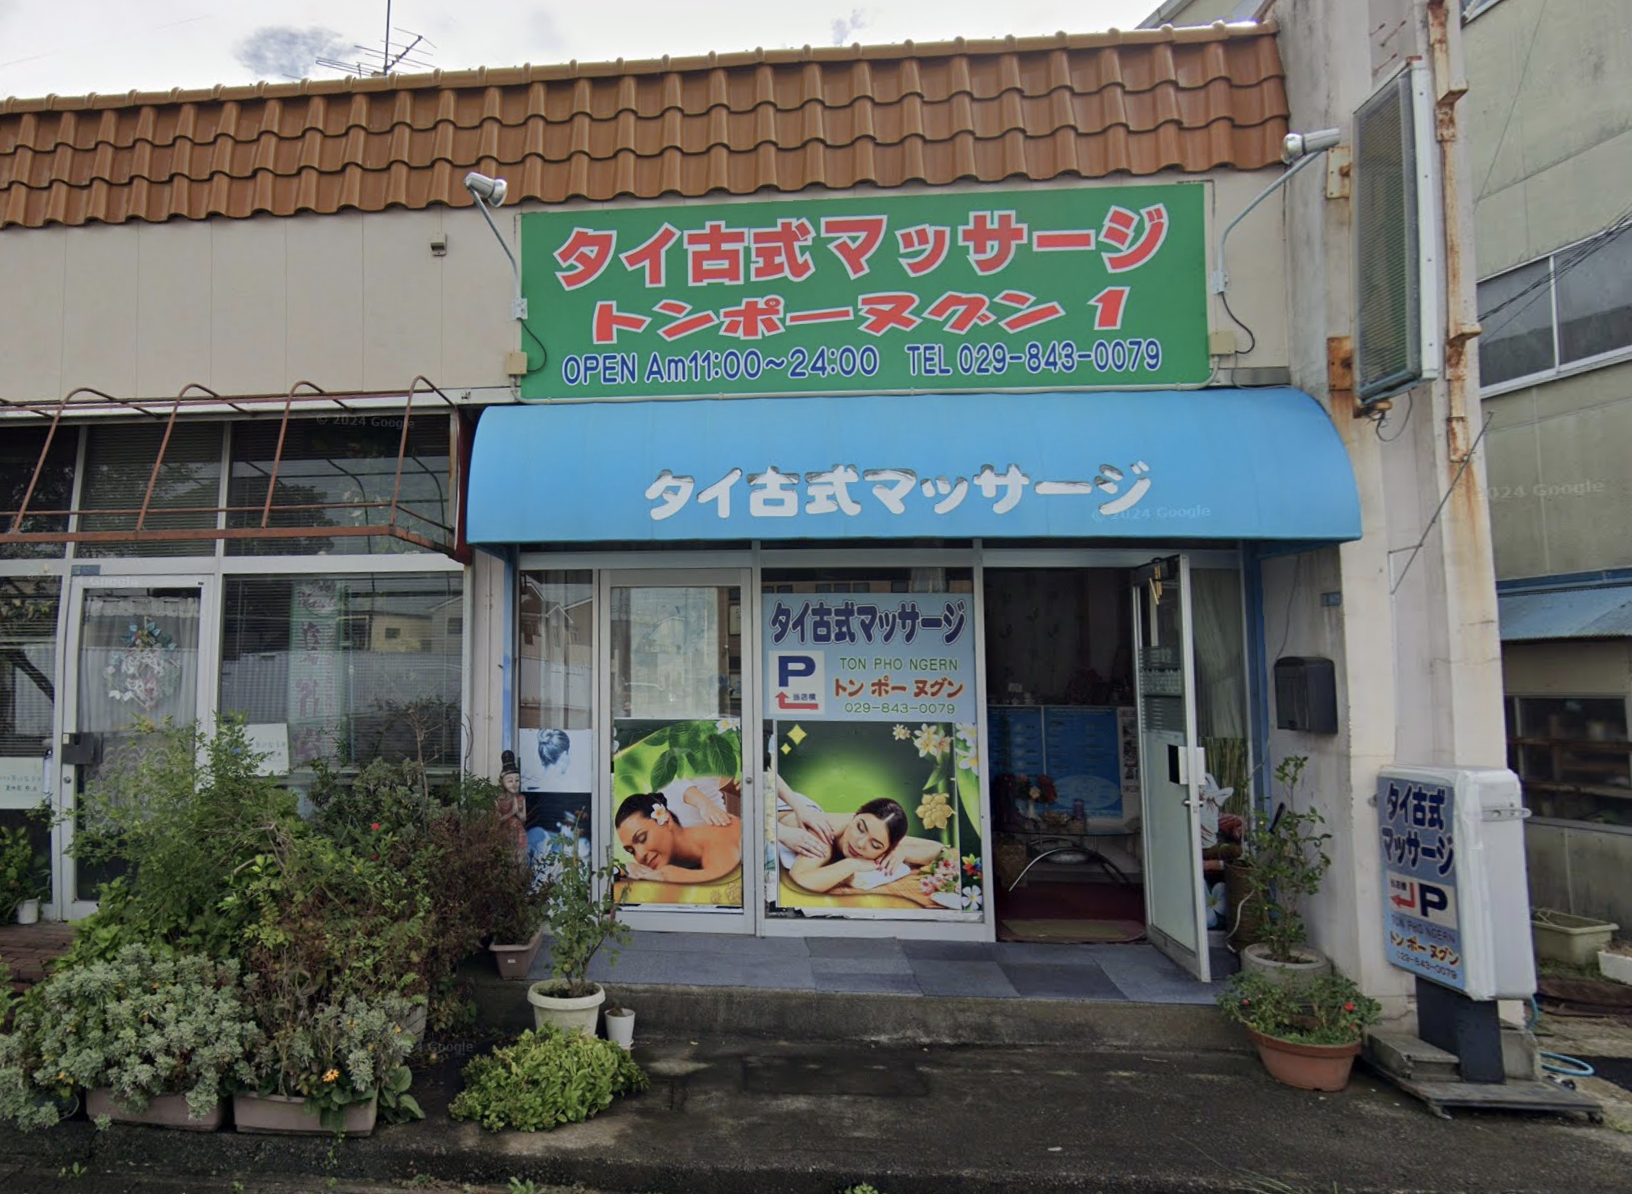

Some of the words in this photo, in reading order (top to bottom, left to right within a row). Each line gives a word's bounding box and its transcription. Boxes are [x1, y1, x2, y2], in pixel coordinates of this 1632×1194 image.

[553, 203, 1169, 291] タイ古式マッサージ
[593, 290, 1066, 344] トンポーヌグン
[1087, 286, 1131, 330] 1
[562, 352, 638, 385] OPEN
[906, 343, 953, 376] TEL
[957, 338, 1162, 376] 029-843-0079
[645, 460, 1151, 520] タイ古式マッサージ
[769, 600, 967, 645] タイ古式マッサージ
[778, 655, 816, 687] P
[840, 657, 867, 670] TON
[874, 657, 903, 671] PHO
[909, 658, 959, 671] NGERN
[793, 693, 816, 701] 当店横
[844, 702, 956, 715] 029-843-0079
[1386, 781, 1446, 831] タイ古式
[1382, 827, 1456, 876] マッサージ
[1418, 883, 1449, 918] P
